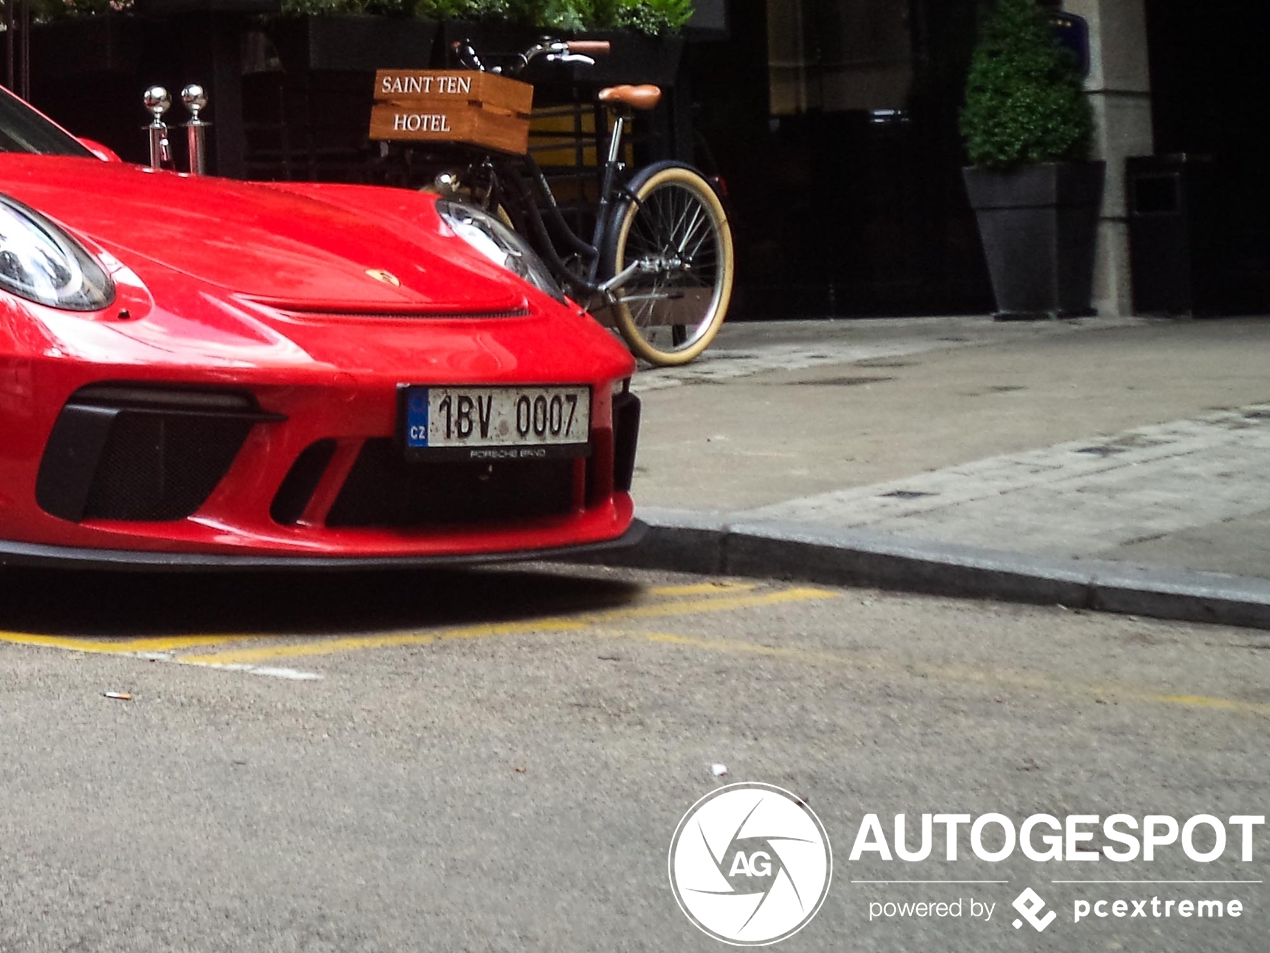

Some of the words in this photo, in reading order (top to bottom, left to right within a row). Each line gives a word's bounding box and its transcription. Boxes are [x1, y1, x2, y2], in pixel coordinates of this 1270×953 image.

[382, 76, 433, 94] SAINT
[437, 76, 471, 94] TEN
[393, 114, 450, 132] HOTEL
[439, 395, 492, 439] 1BV
[516, 395, 578, 437] 0007
[410, 426, 426, 439] CZ
